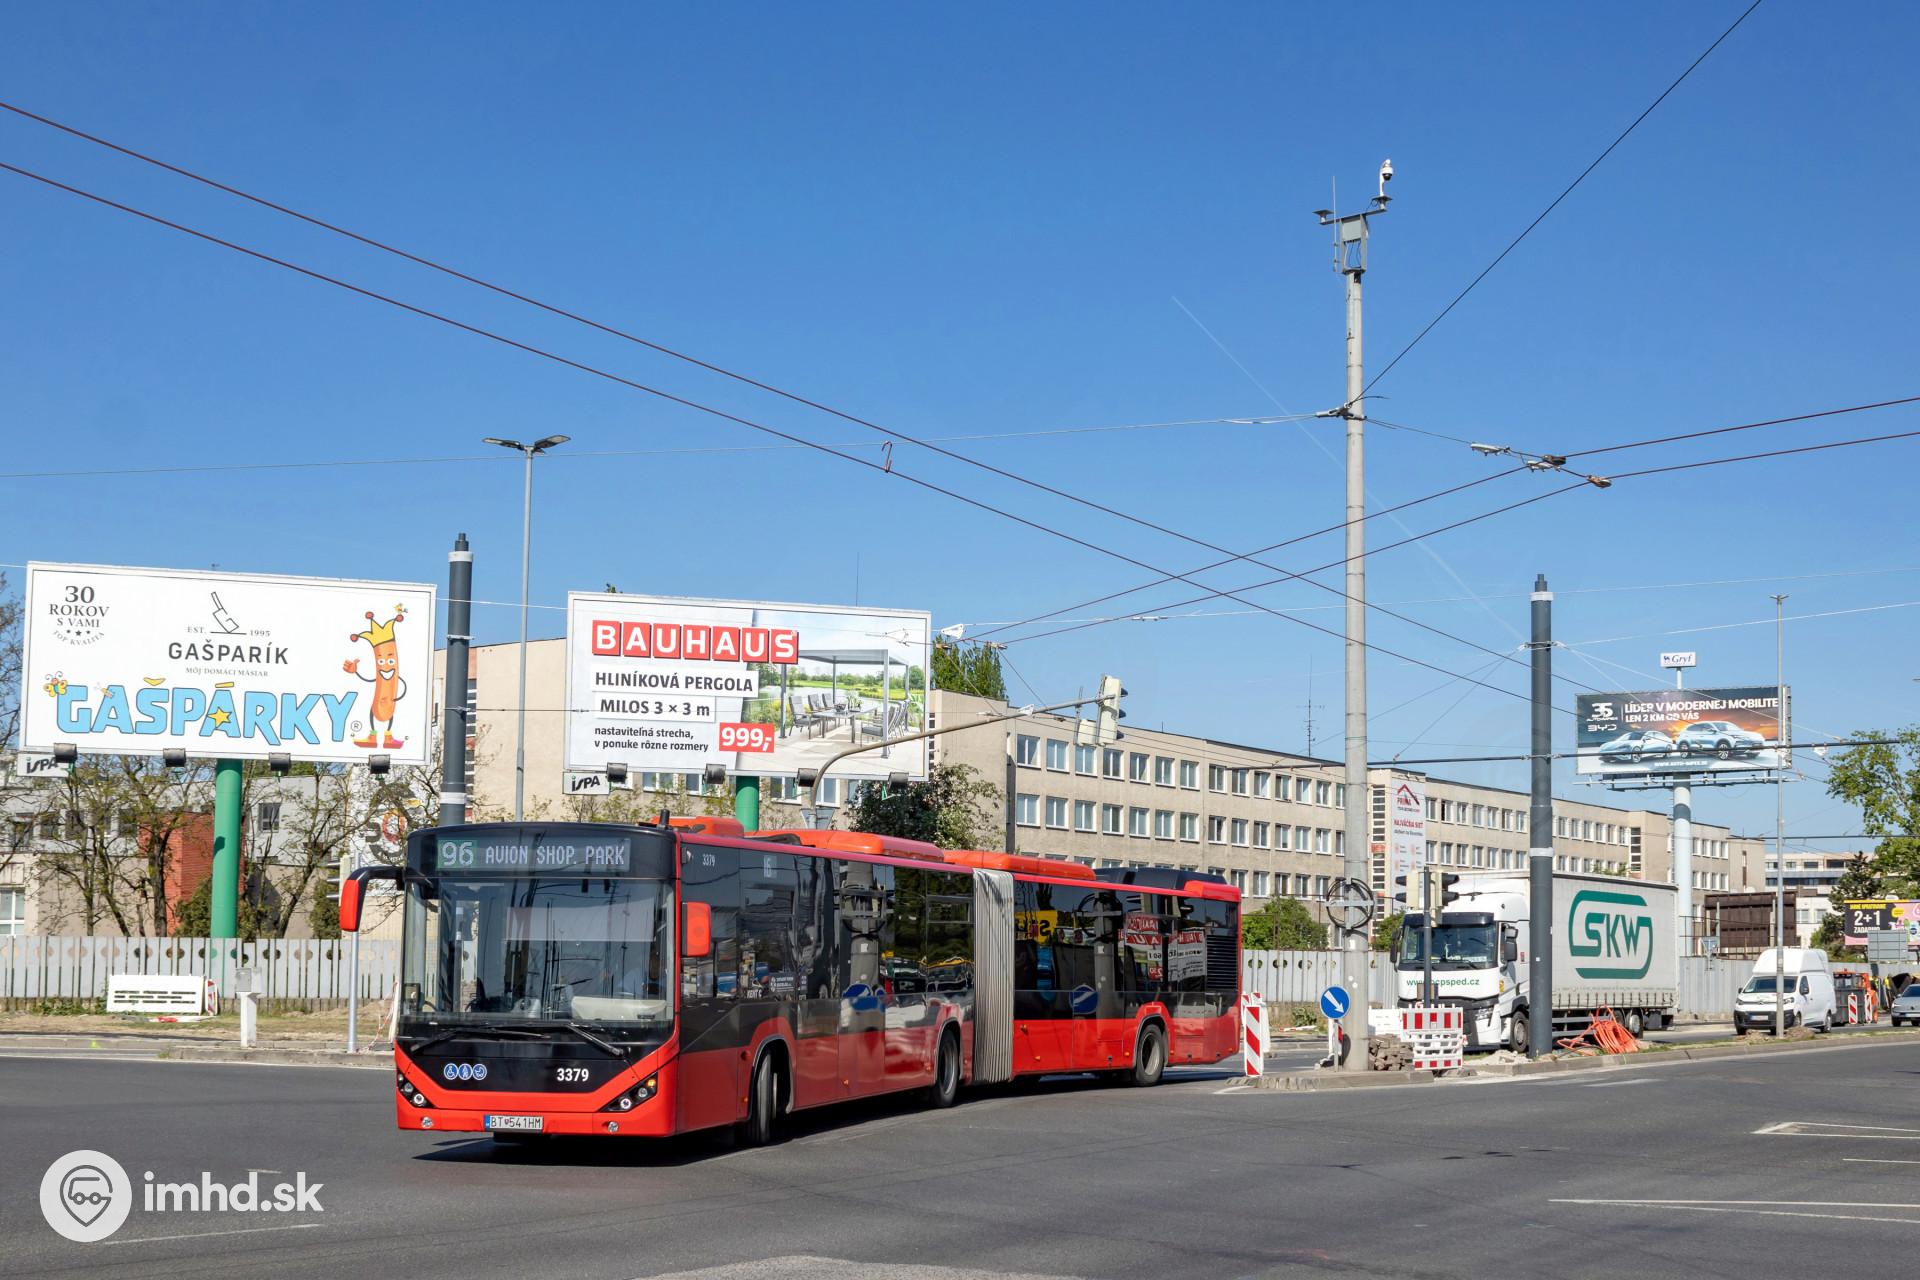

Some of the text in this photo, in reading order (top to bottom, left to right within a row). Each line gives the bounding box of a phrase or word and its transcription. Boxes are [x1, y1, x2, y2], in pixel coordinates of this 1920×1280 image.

[65, 586, 95, 603] 30
[49, 604, 109, 617] ROKOV
[57, 618, 63, 626] S
[187, 626, 207, 634] EST.
[594, 623, 796, 660] BAUHAUS
[168, 638, 288, 665] GAŠPARÍK
[595, 671, 753, 692] HLINÍKOVÁ PERGOLA
[56, 677, 358, 746] GAŠPÁRKY
[600, 699, 650, 714] MILOS
[654, 701, 663, 714] 3
[682, 702, 691, 715] 3
[696, 705, 710, 716] m
[1624, 698, 1779, 713] LÍDER V MODERNEJ MOBILITE
[1643, 714, 1648, 722] 2
[1680, 710, 1699, 720] VÁS
[594, 726, 694, 739] nastaviteľná strecha,
[594, 739, 709, 752] v ponuke rôzne rozmery
[442, 842, 625, 866] 96 AVION SHOP. PARK
[702, 853, 715, 867] 3379
[1854, 911, 1880, 926] 2+1
[1571, 911, 1653, 957] SKW
[556, 1068, 590, 1081] 3379
